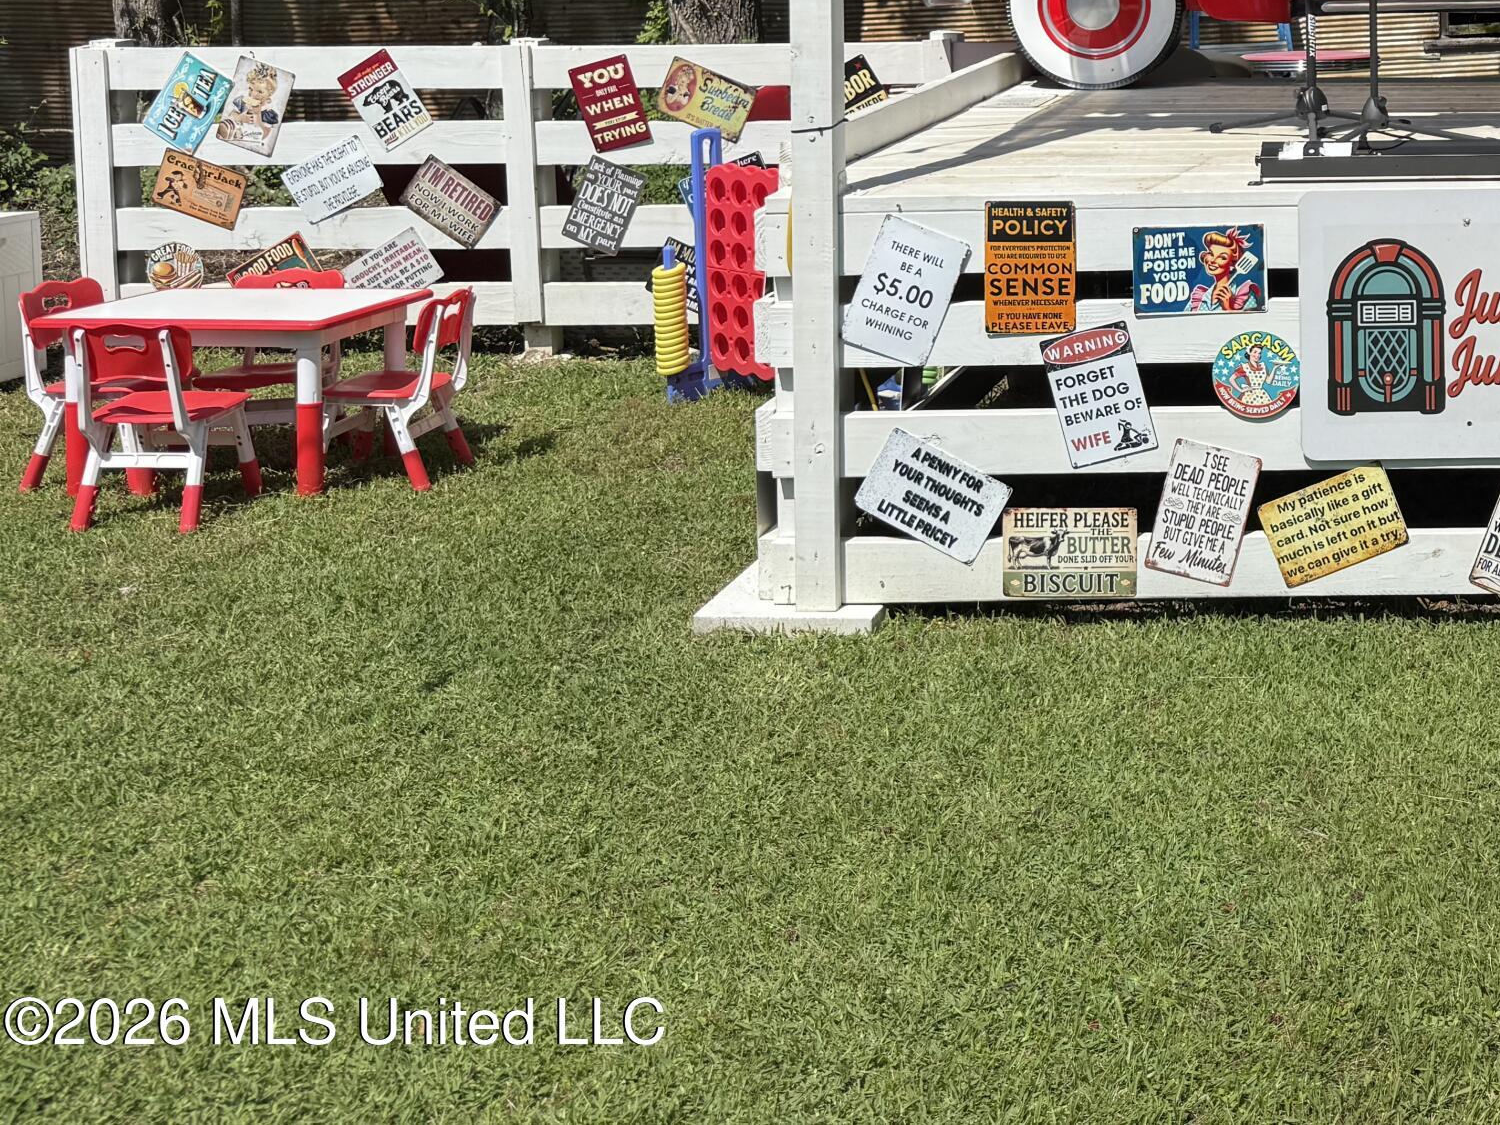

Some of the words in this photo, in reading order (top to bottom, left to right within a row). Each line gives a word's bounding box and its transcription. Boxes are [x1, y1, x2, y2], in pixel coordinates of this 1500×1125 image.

[347, 62, 394, 96] STRONGER
[578, 63, 625, 88] YOU
[157, 106, 185, 140] ICE
[192, 69, 217, 101] TEA
[585, 94, 635, 116] WHEN
[372, 100, 423, 139] BEARS
[594, 124, 646, 144] TRYING
[422, 162, 446, 188] I'M
[440, 175, 494, 222] RETIRED
[579, 181, 611, 207] DOES
[609, 193, 634, 216] NOT
[409, 194, 429, 211] FOR
[431, 209, 448, 223] MY
[449, 222, 474, 242] WIFE
[415, 183, 440, 203] NOW
[448, 206, 479, 231] WORK
[992, 208, 1024, 216] HEALTH
[1027, 208, 1033, 216] &
[1036, 208, 1067, 216] SAFETY
[570, 208, 623, 238] EMERGENCY
[992, 220, 1067, 235] POLICY
[151, 244, 175, 261] GREAT
[362, 259, 368, 267] IF
[369, 251, 383, 261] YOU
[384, 241, 398, 253] ARE
[891, 241, 920, 259] THERE
[924, 252, 944, 268] WILL
[1143, 257, 1196, 273] POISON
[1144, 249, 1175, 260] MAKE
[1179, 247, 1195, 256] ME
[900, 262, 912, 272] BE
[914, 267, 922, 277] A
[988, 263, 1072, 275] COMMON
[1153, 271, 1186, 282] YOUR
[874, 272, 933, 308] $5.00
[990, 278, 1070, 296] SENSE
[1140, 281, 1190, 304] FOOD
[862, 298, 906, 321] CHARGE
[908, 314, 928, 330] FOR
[992, 322, 1032, 330] PLEASE
[1036, 322, 1069, 330] LEAVE
[866, 317, 912, 340] WHINING
[1047, 332, 1126, 361] WARNING
[1221, 332, 1295, 362] SARCASM
[1055, 366, 1115, 391] FORGET
[1060, 392, 1089, 409] THE
[1093, 382, 1130, 401] DOG
[1218, 387, 1231, 403] NOW
[1228, 399, 1245, 412] BEING
[1246, 405, 1269, 413] SERVED
[1268, 396, 1286, 411] DAILY
[1065, 403, 1120, 426] BEWARE
[1124, 397, 1142, 411] OF
[1071, 430, 1111, 451] WIFE
[911, 447, 922, 461] A
[921, 451, 962, 480] PENNY
[960, 472, 983, 493] FOR
[1203, 452, 1210, 467] I
[1211, 454, 1230, 472] SEE
[892, 459, 924, 486] YOUR
[926, 476, 985, 517] THOUGHTS
[1174, 463, 1204, 485] DEAD
[1208, 472, 1249, 497] PEOPLE
[902, 490, 942, 519] SEEMS
[940, 511, 950, 525] A
[1014, 512, 1068, 528] HEIFER
[1074, 512, 1129, 527] PLEASE
[877, 499, 915, 528] LITTLE
[915, 520, 958, 549] PRICEY
[1067, 536, 1131, 554] BUTTER
[1024, 573, 1119, 593] BISCUIT
